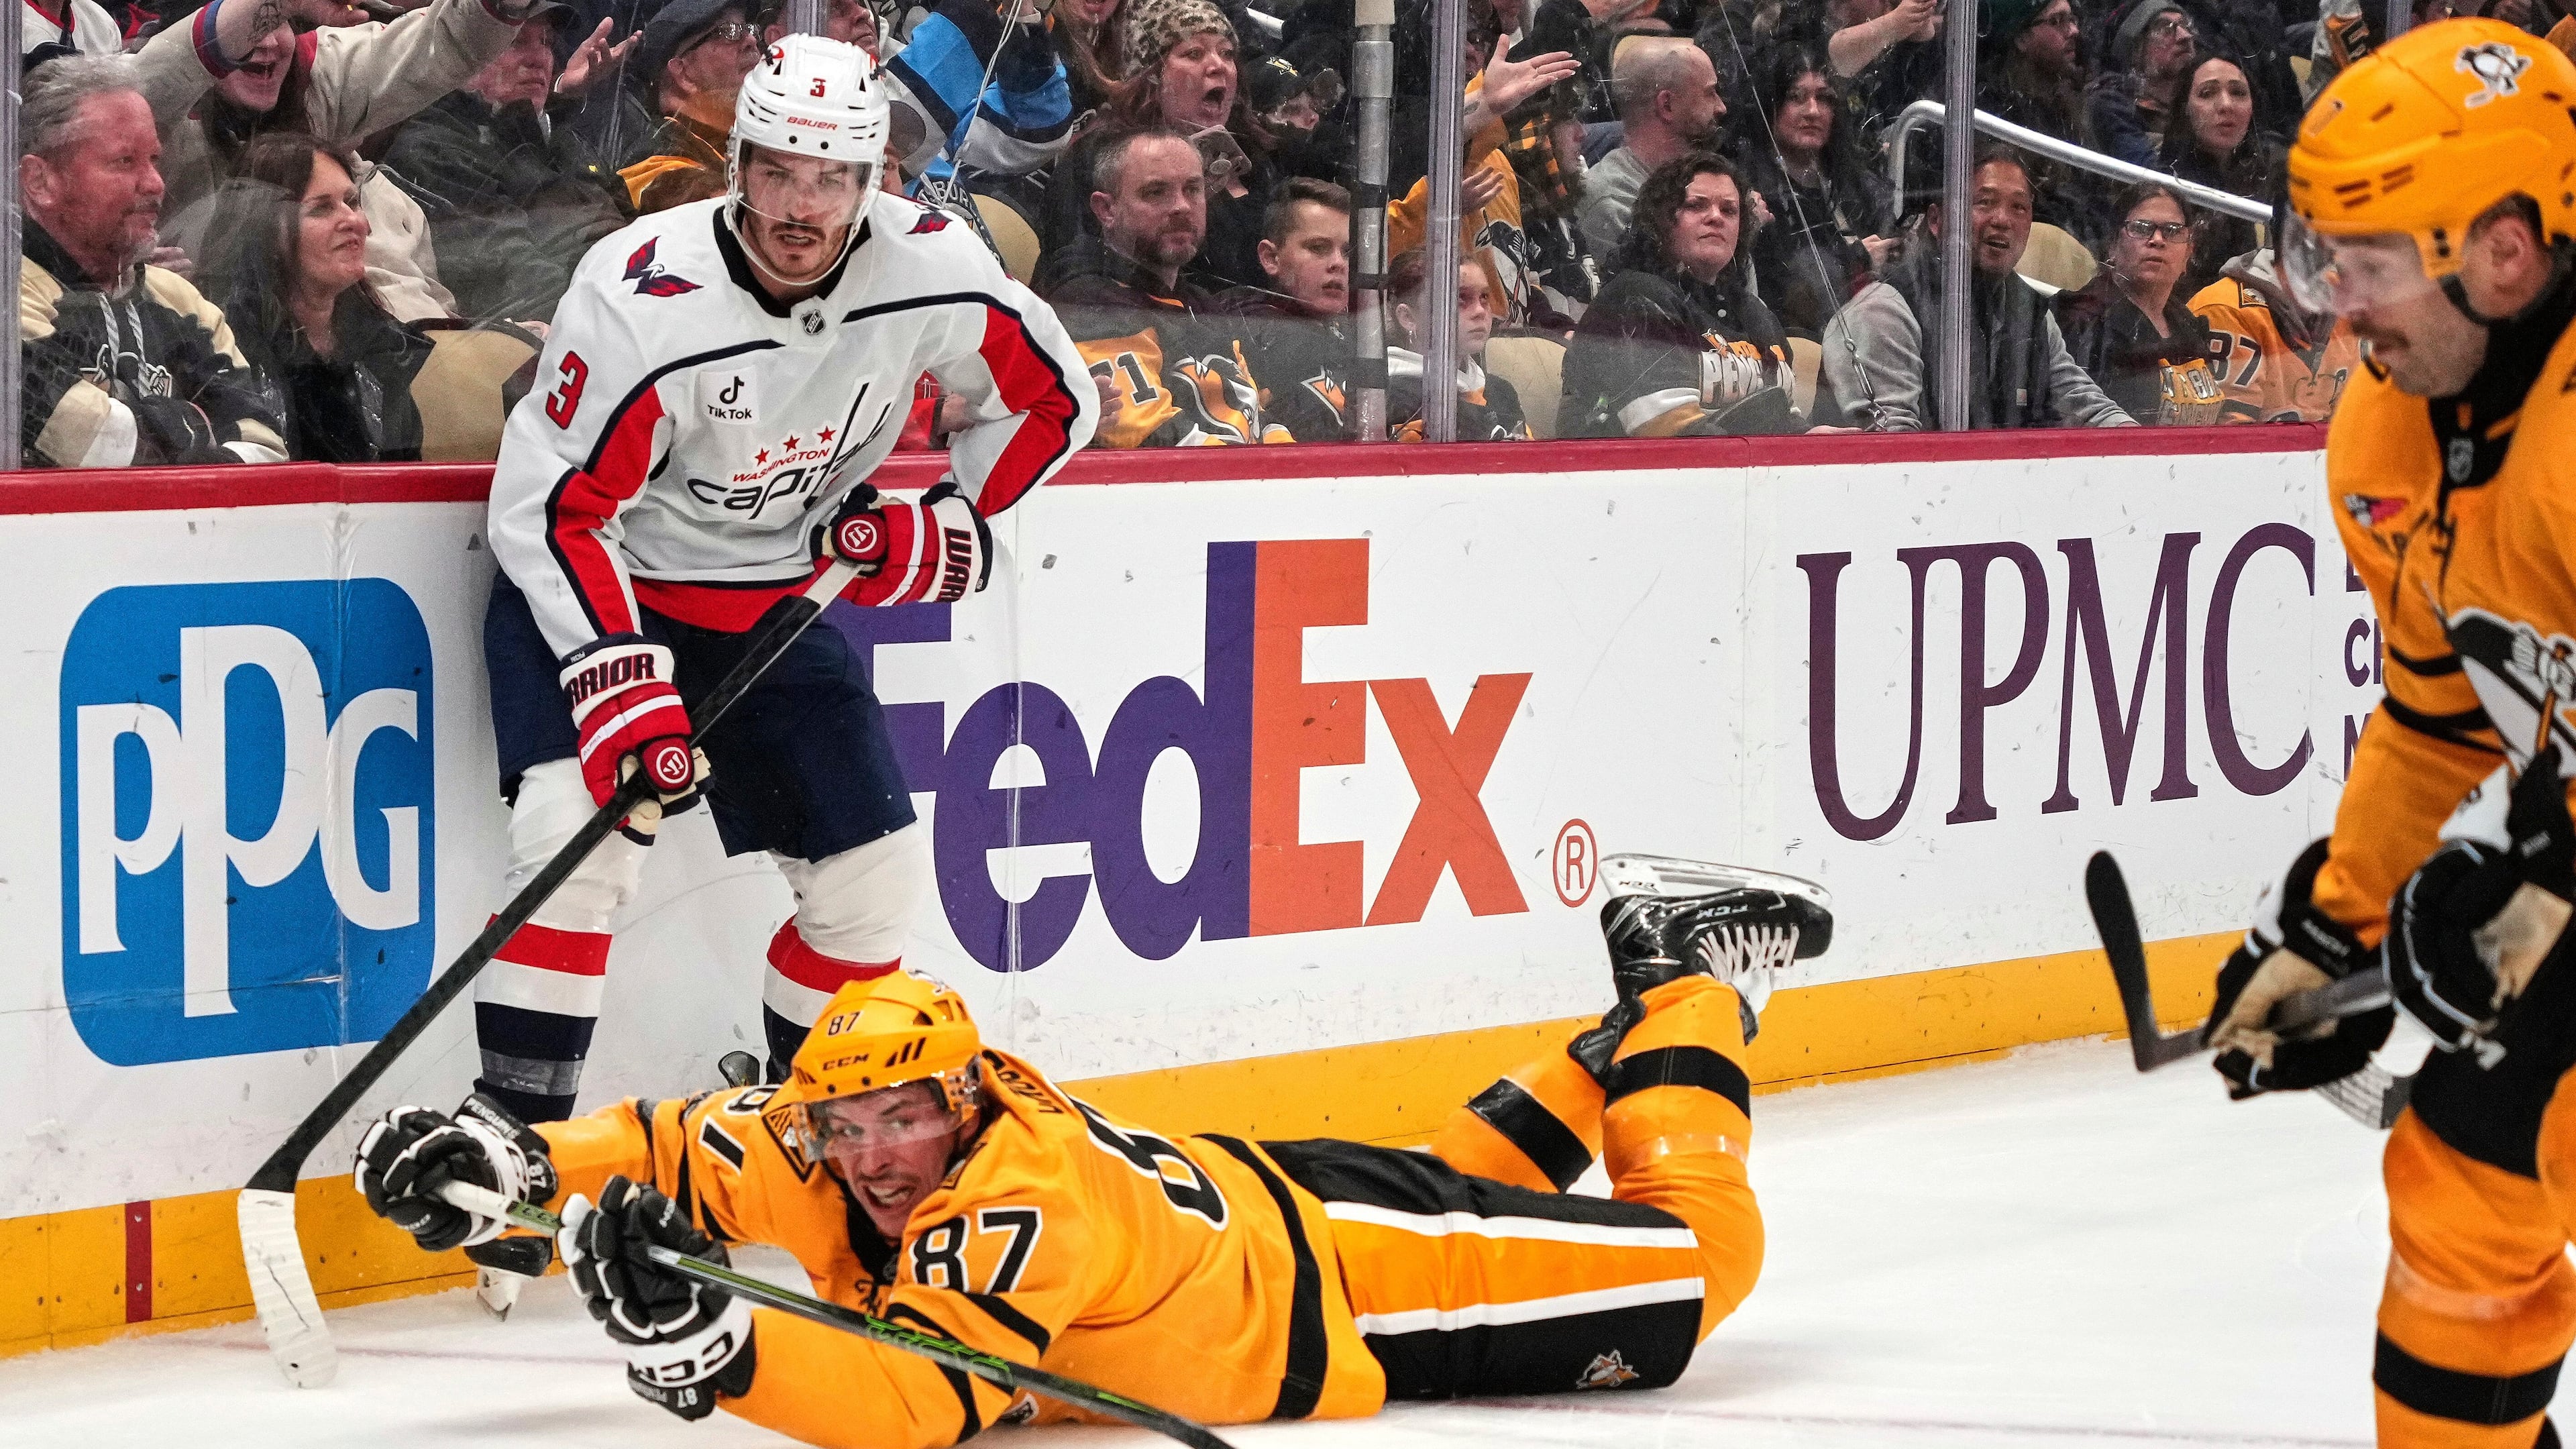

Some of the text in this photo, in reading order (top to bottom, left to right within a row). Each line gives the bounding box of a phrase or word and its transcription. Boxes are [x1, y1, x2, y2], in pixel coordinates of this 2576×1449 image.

[810, 78, 826, 97] 3
[545, 350, 588, 429] 3
[707, 404, 753, 419] TikTok
[733, 447, 830, 482] WASHINGTON
[1796, 522, 2316, 841] UPMC
[820, 538, 1534, 973] FedEx
[76, 624, 421, 1018] PPG
[827, 1010, 862, 1036] 87
[822, 1053, 870, 1071] CCM
[529, 1163, 547, 1189] 87
[909, 1205, 1043, 1295] 87
